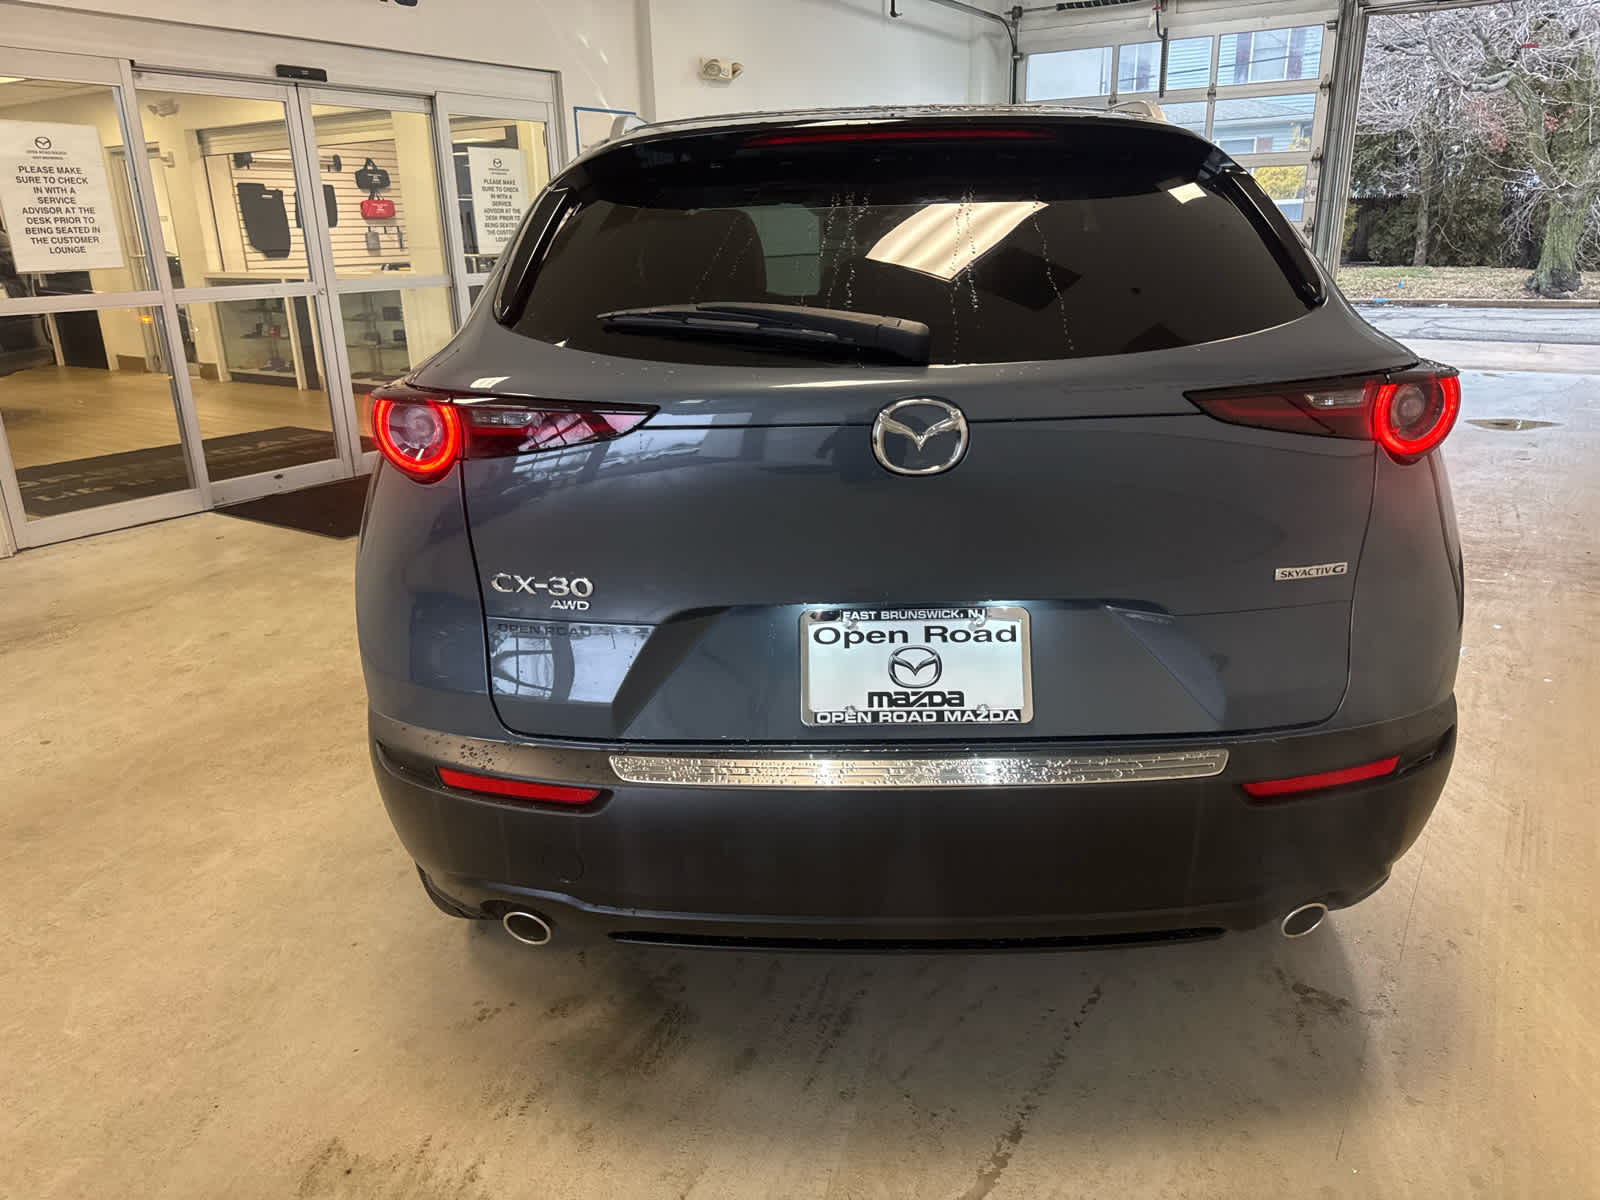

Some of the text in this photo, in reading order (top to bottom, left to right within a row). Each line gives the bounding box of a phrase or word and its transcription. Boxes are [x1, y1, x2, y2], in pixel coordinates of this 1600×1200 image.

[18, 166, 82, 174] PLEASE MAKE
[16, 176, 41, 184] SURE
[43, 176, 55, 184] TO
[33, 186, 42, 194] IN
[45, 186, 67, 194] WITH
[55, 226, 90, 234] SEATED
[51, 236, 99, 244] CUSTOMER
[491, 572, 594, 598] CX-30
[550, 600, 590, 610] AWD
[880, 610, 965, 620] BRUNSWICK,
[968, 609, 985, 619] NJ
[813, 625, 1017, 648] Open Road
[816, 710, 1019, 723] OPEN ROAD MAZDA
